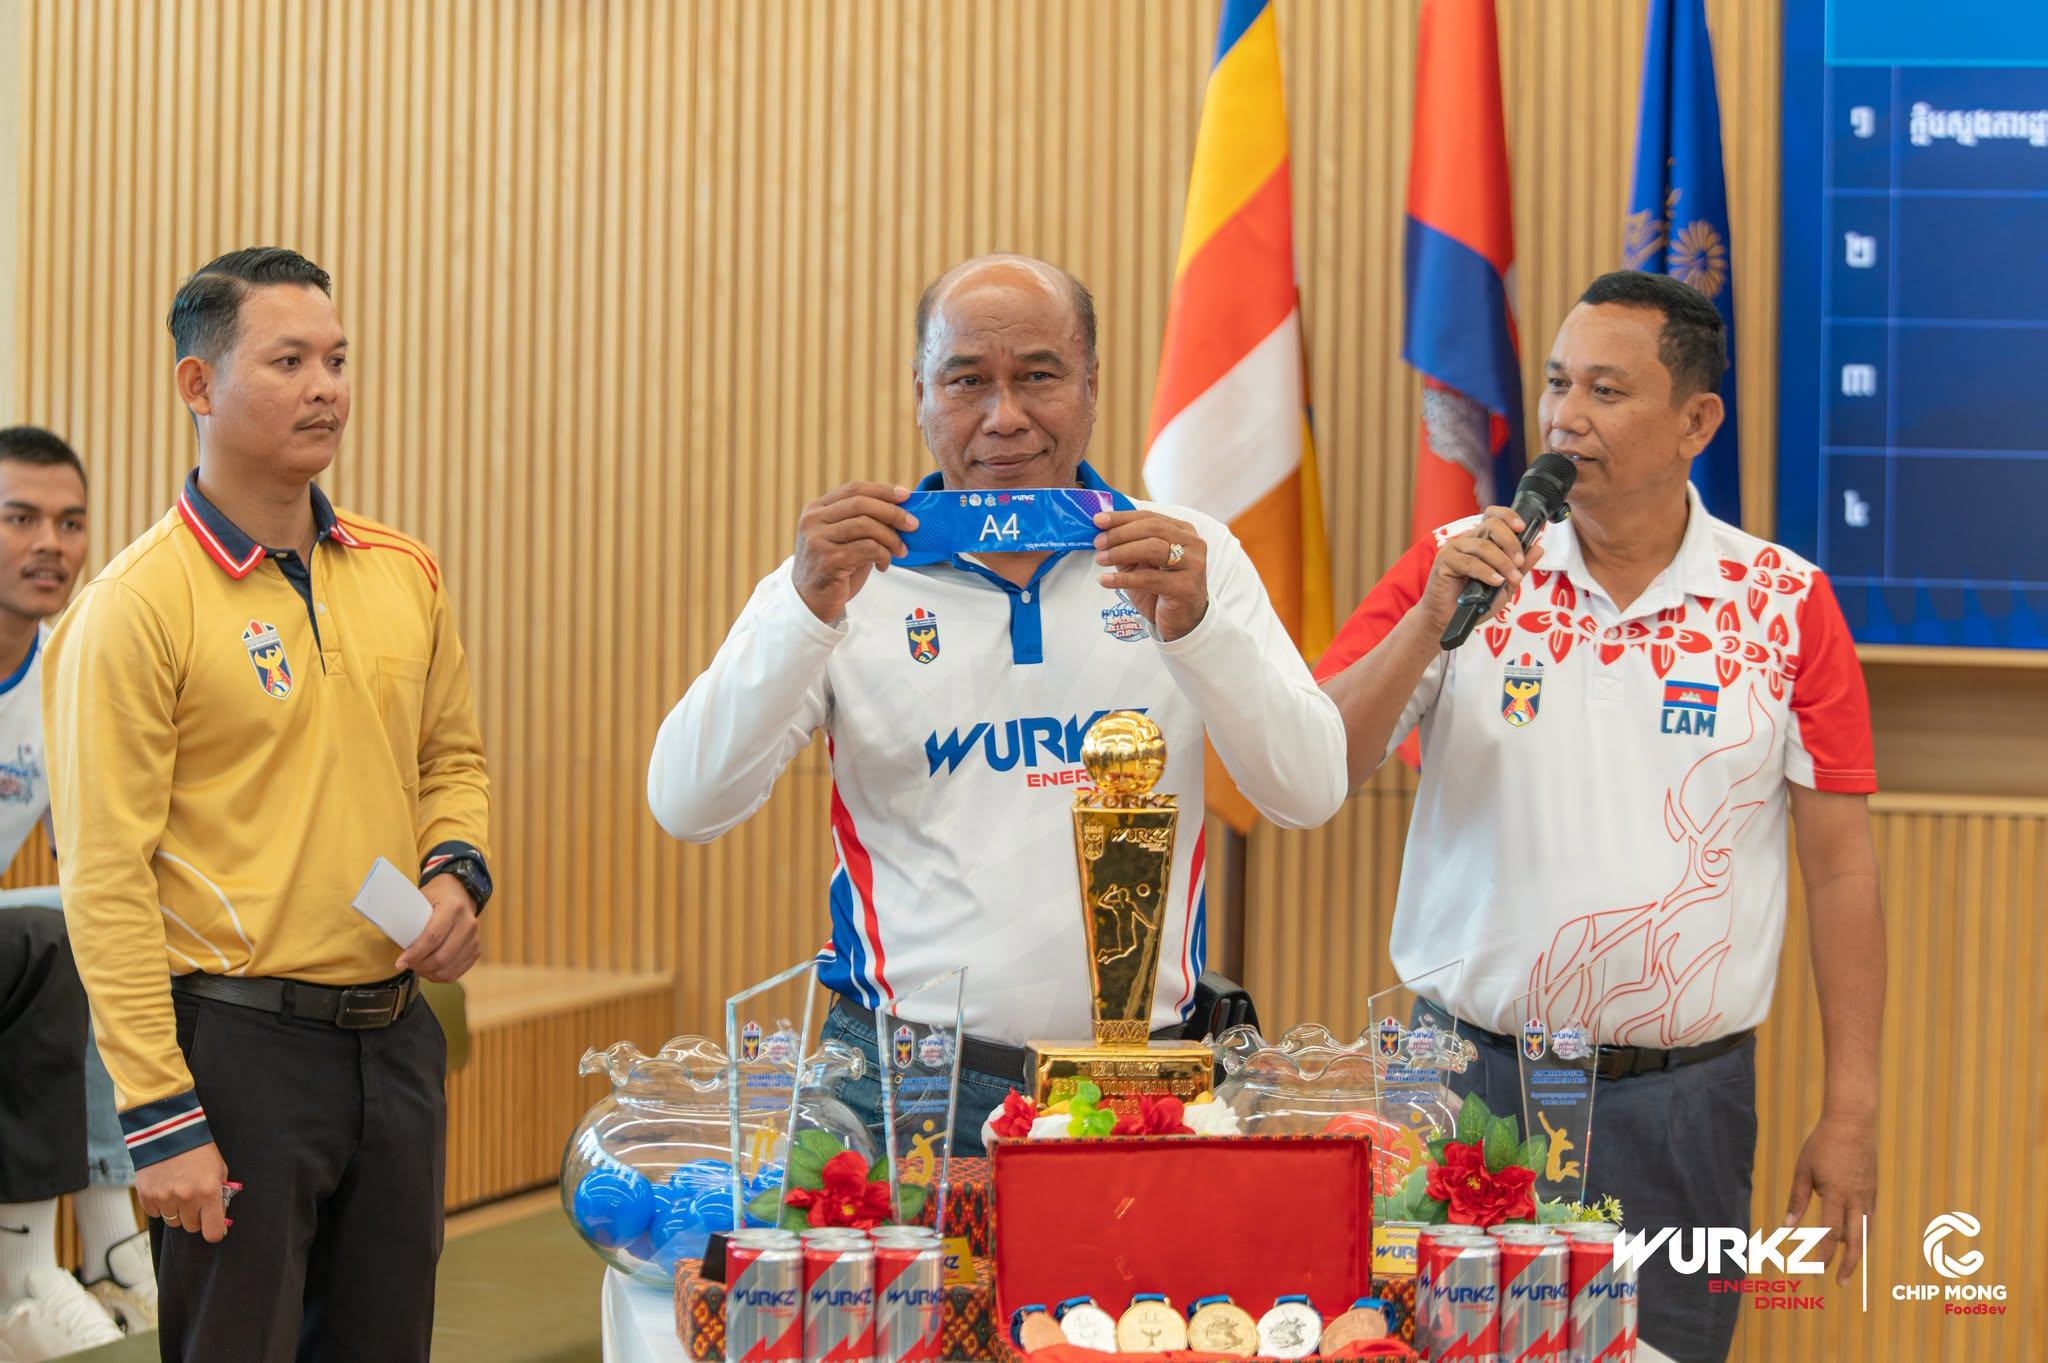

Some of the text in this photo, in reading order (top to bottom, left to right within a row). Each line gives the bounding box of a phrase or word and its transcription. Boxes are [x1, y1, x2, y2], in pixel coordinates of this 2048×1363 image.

[1845, 231, 1877, 268] ២
[1841, 364, 1877, 396] ៣
[1843, 490, 1870, 527] ៤
[979, 513, 1020, 542] A4
[1102, 607, 1139, 618] WURK
[1660, 709, 1716, 737] CAM
[924, 707, 1149, 779] WURK
[1027, 769, 1092, 787] ENER
[1111, 828, 1169, 843] WURKZ
[1171, 1080, 1195, 1096] CUP
[1376, 1245, 1417, 1259] WUR
[733, 1288, 797, 1306] WURKZ
[811, 1288, 872, 1306] WURKZ
[1433, 1285, 1496, 1303] WURKZ
[1589, 1282, 1636, 1299] WURK
